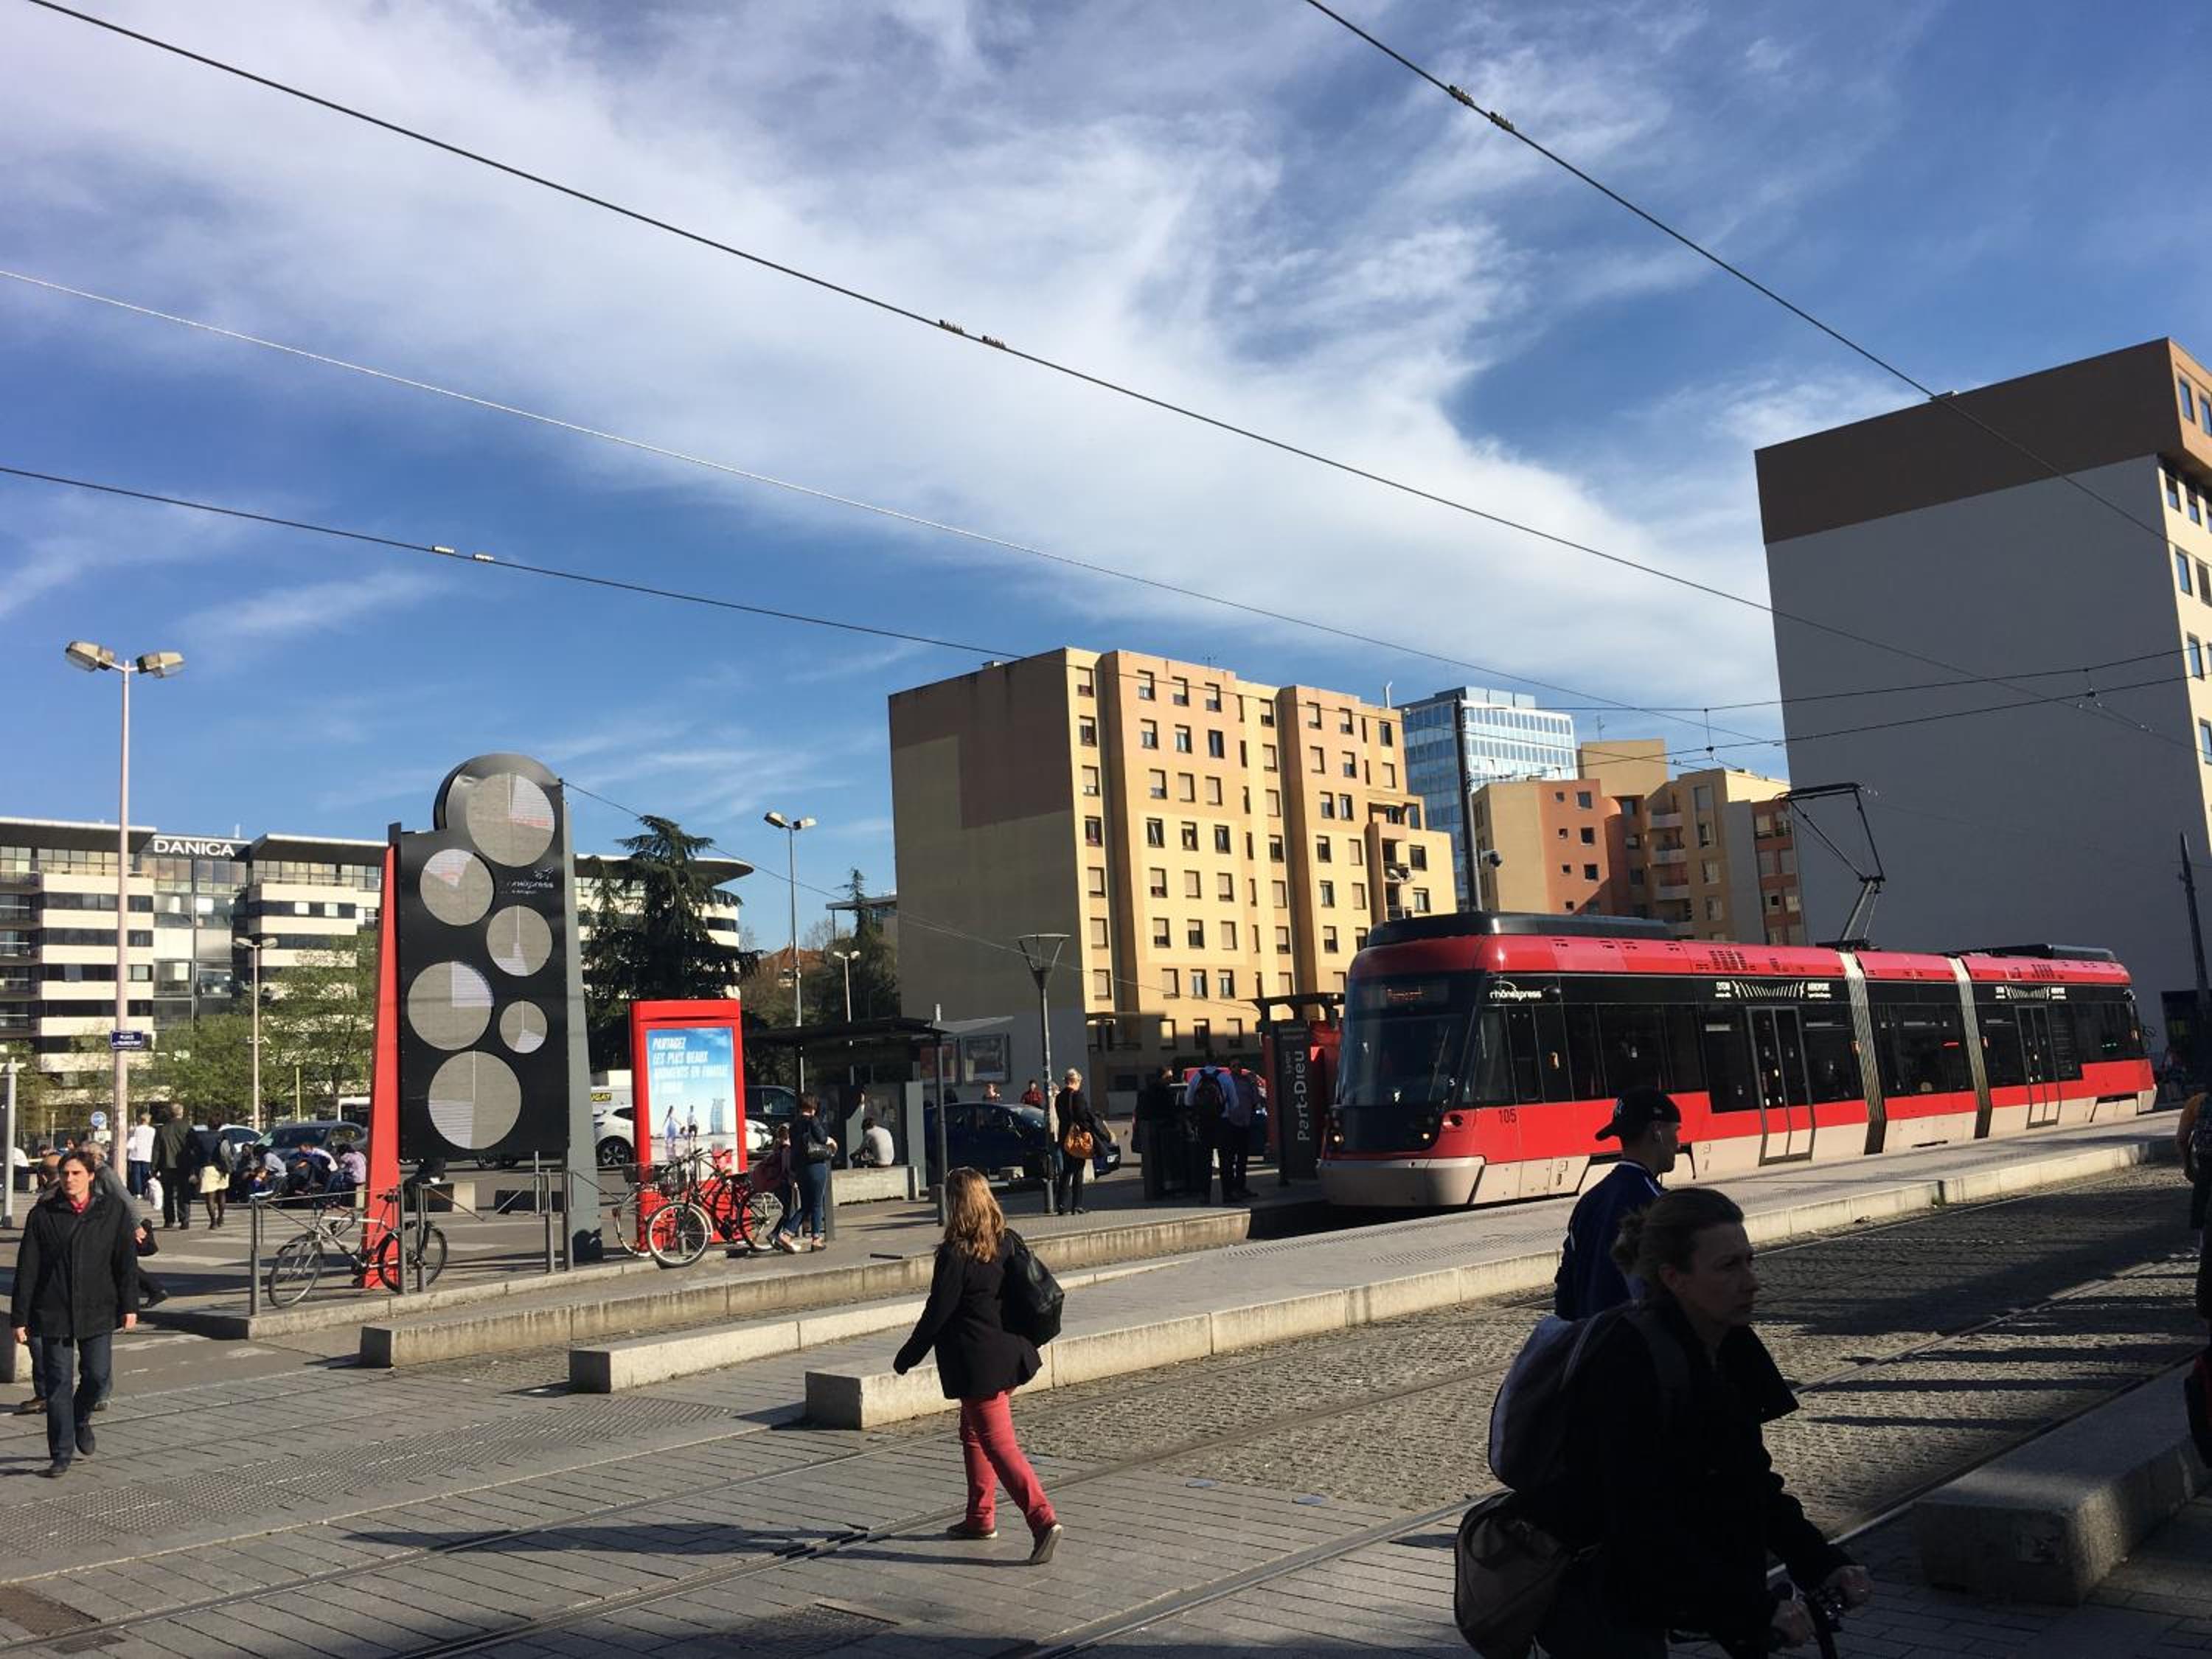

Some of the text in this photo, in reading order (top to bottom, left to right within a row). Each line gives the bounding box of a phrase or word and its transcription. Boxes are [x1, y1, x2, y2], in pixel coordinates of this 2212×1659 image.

[153, 840, 236, 857] DANICA
[653, 1037, 686, 1051] PARTAGEZ
[653, 1051, 709, 1065] LES PLUS BEAUX
[1294, 1051, 1310, 1141] Part-Dieu
[1498, 1109, 1517, 1123] 105
